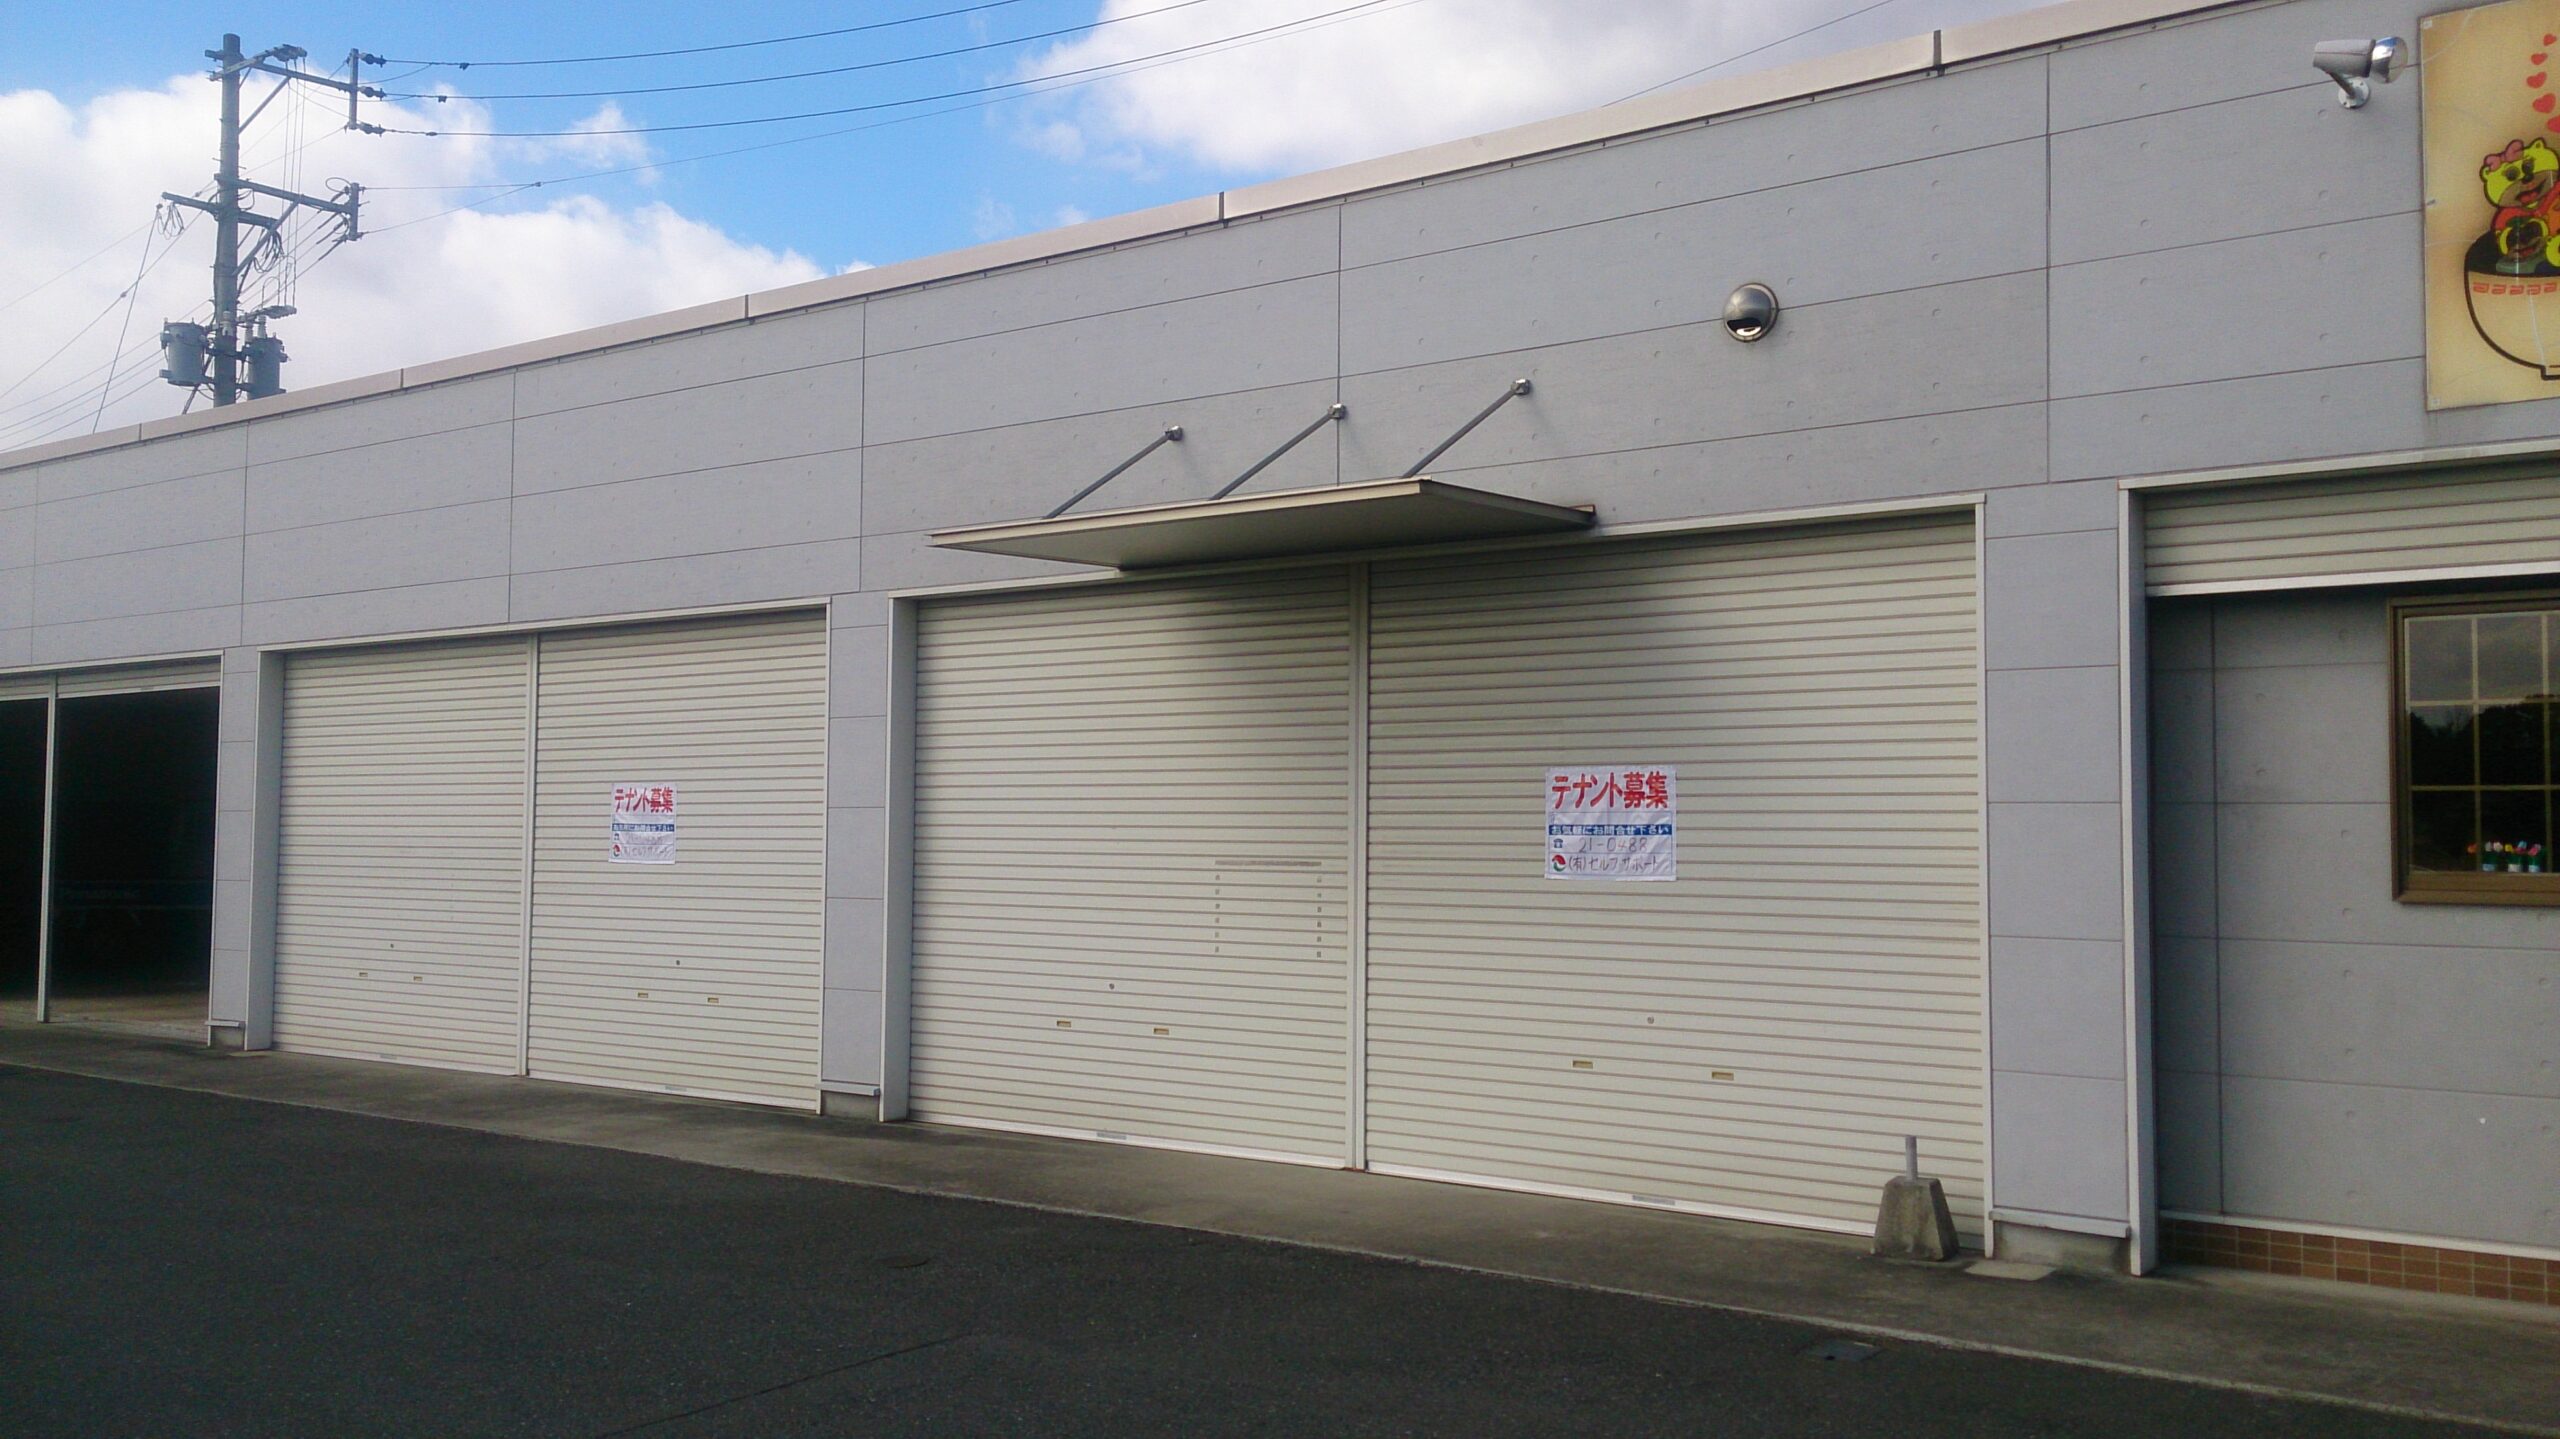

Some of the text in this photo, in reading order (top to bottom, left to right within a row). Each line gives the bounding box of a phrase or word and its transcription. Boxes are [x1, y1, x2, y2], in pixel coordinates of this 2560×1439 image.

[614, 786, 674, 813] テナント募集
[1551, 771, 1669, 809] テナント募集
